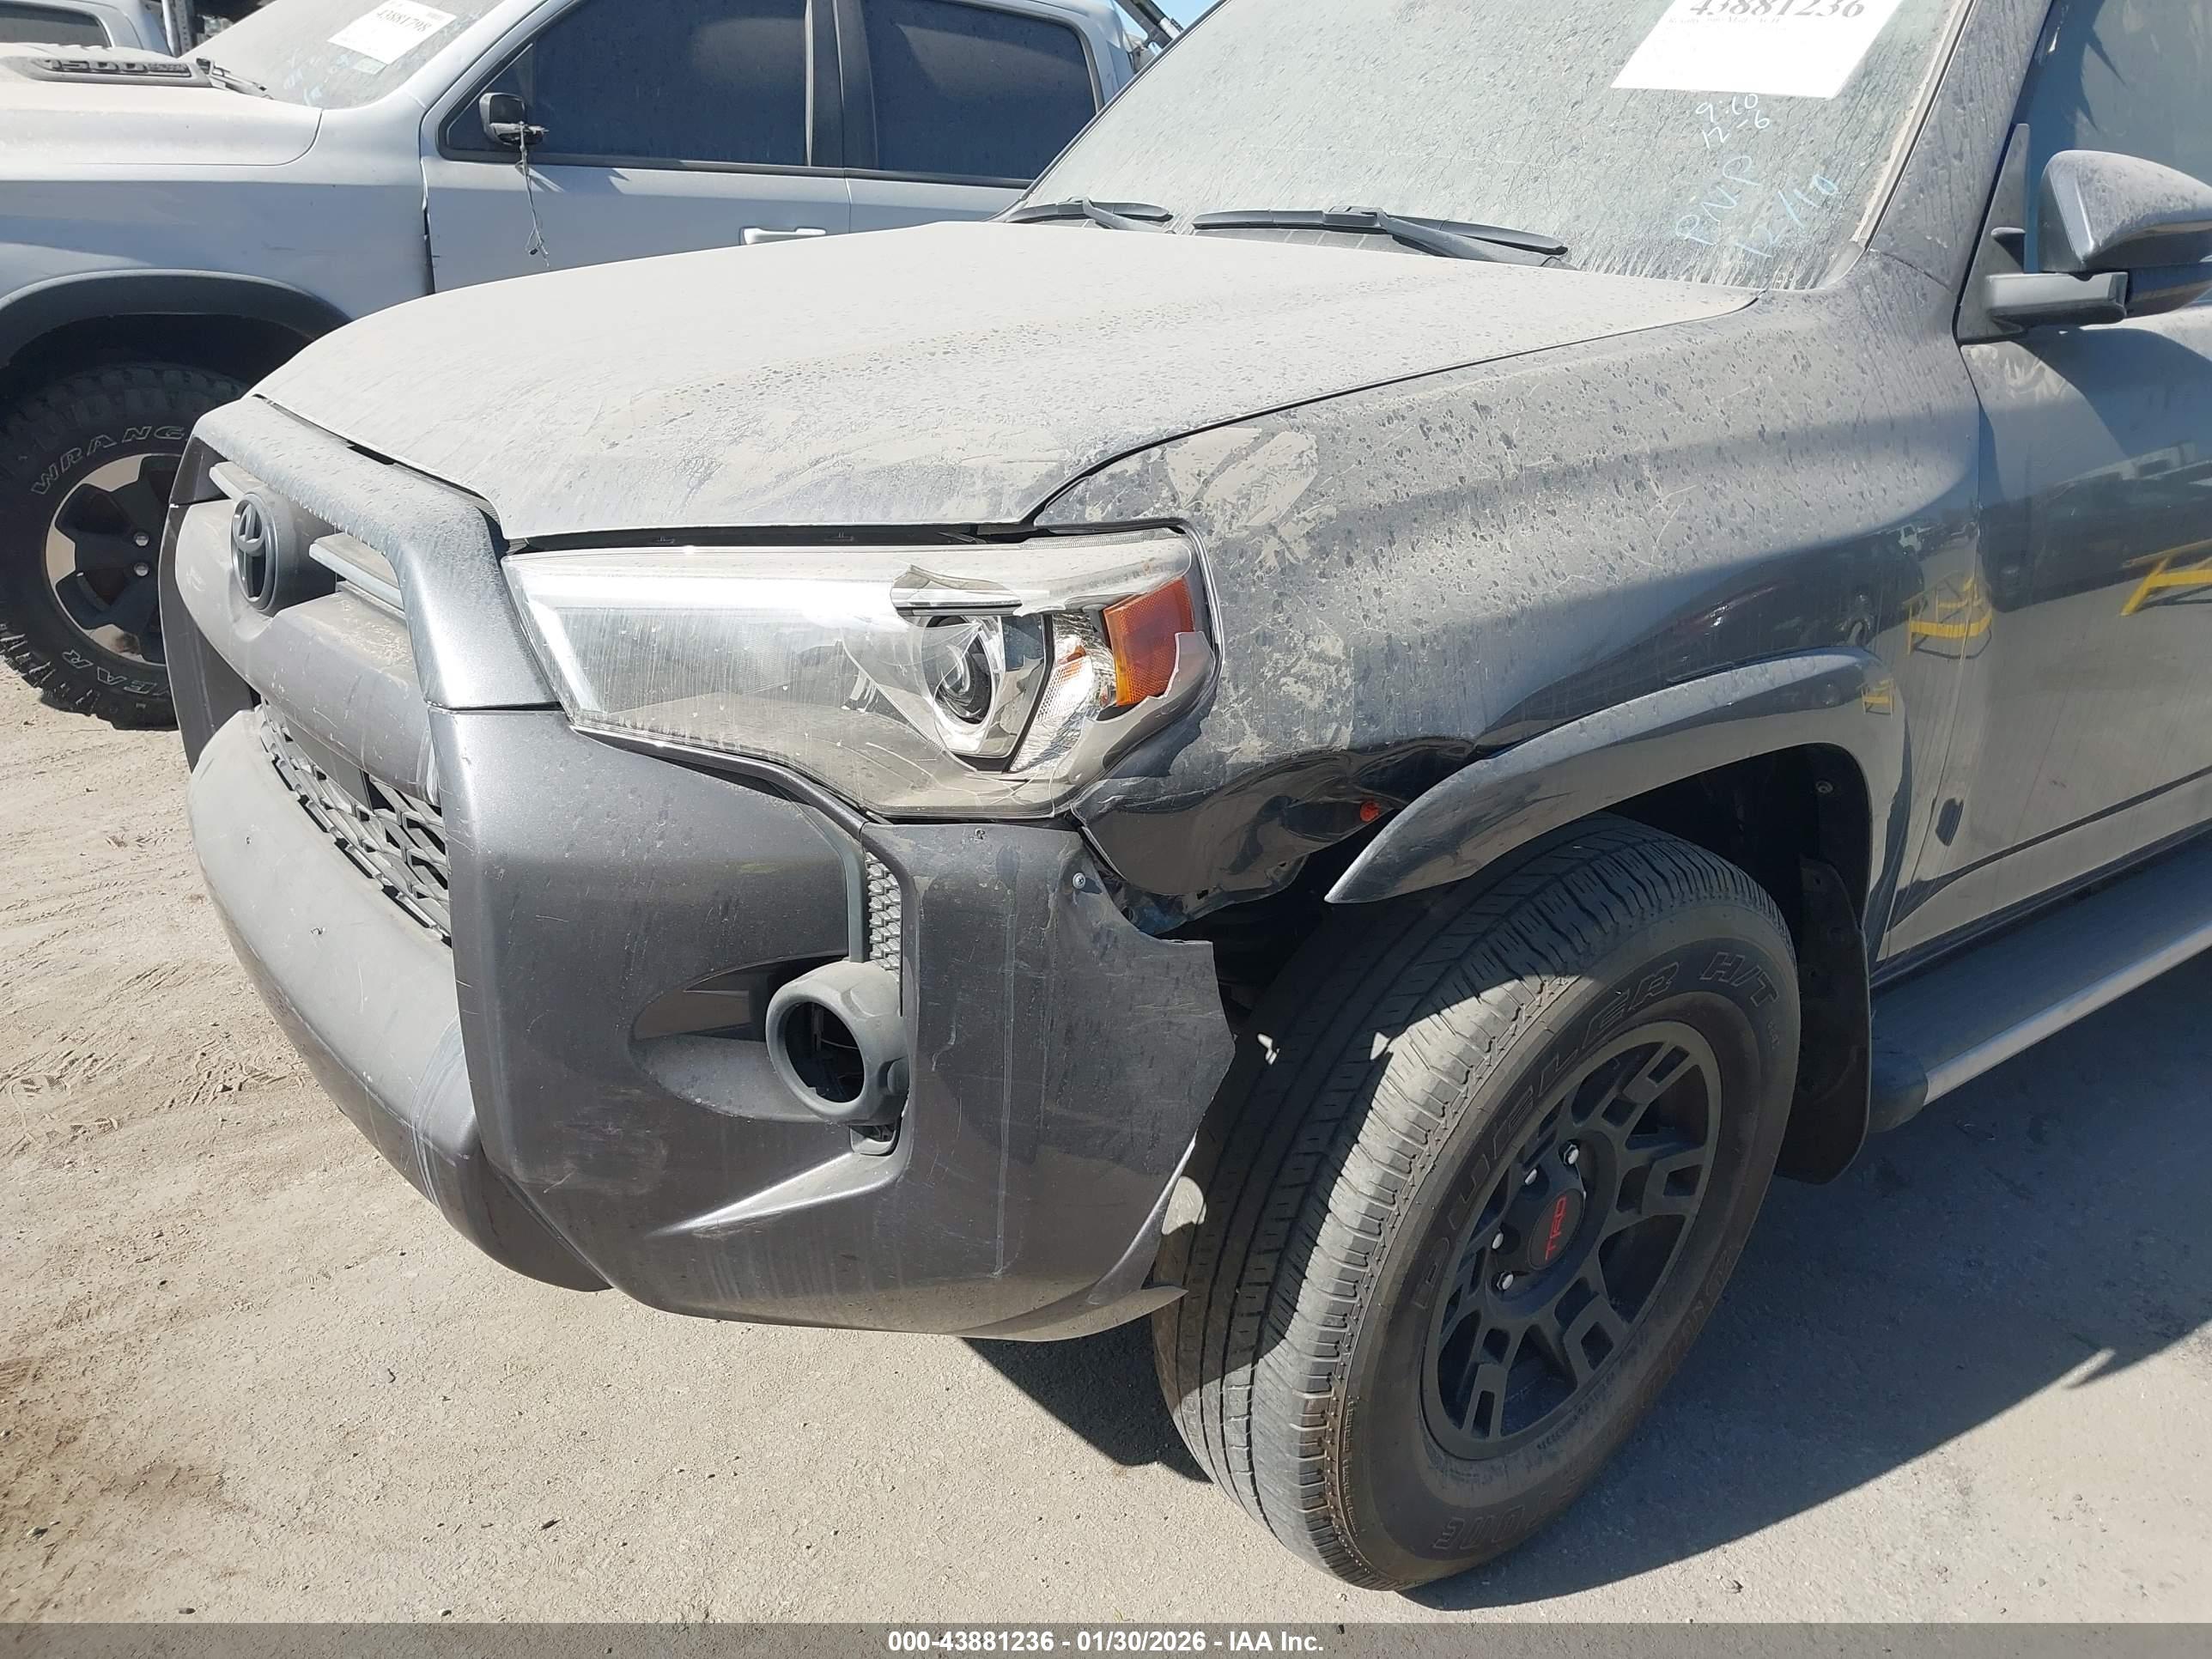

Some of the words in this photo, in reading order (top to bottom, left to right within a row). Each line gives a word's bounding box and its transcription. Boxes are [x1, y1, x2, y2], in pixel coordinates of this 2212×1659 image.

[1689, 0, 1866, 18] 43881236
[31, 425, 188, 495] WRANG
[1409, 960, 1680, 1311] DUELER
[1698, 951, 1780, 1008] H/T
[1544, 1194, 1568, 1262] TRD
